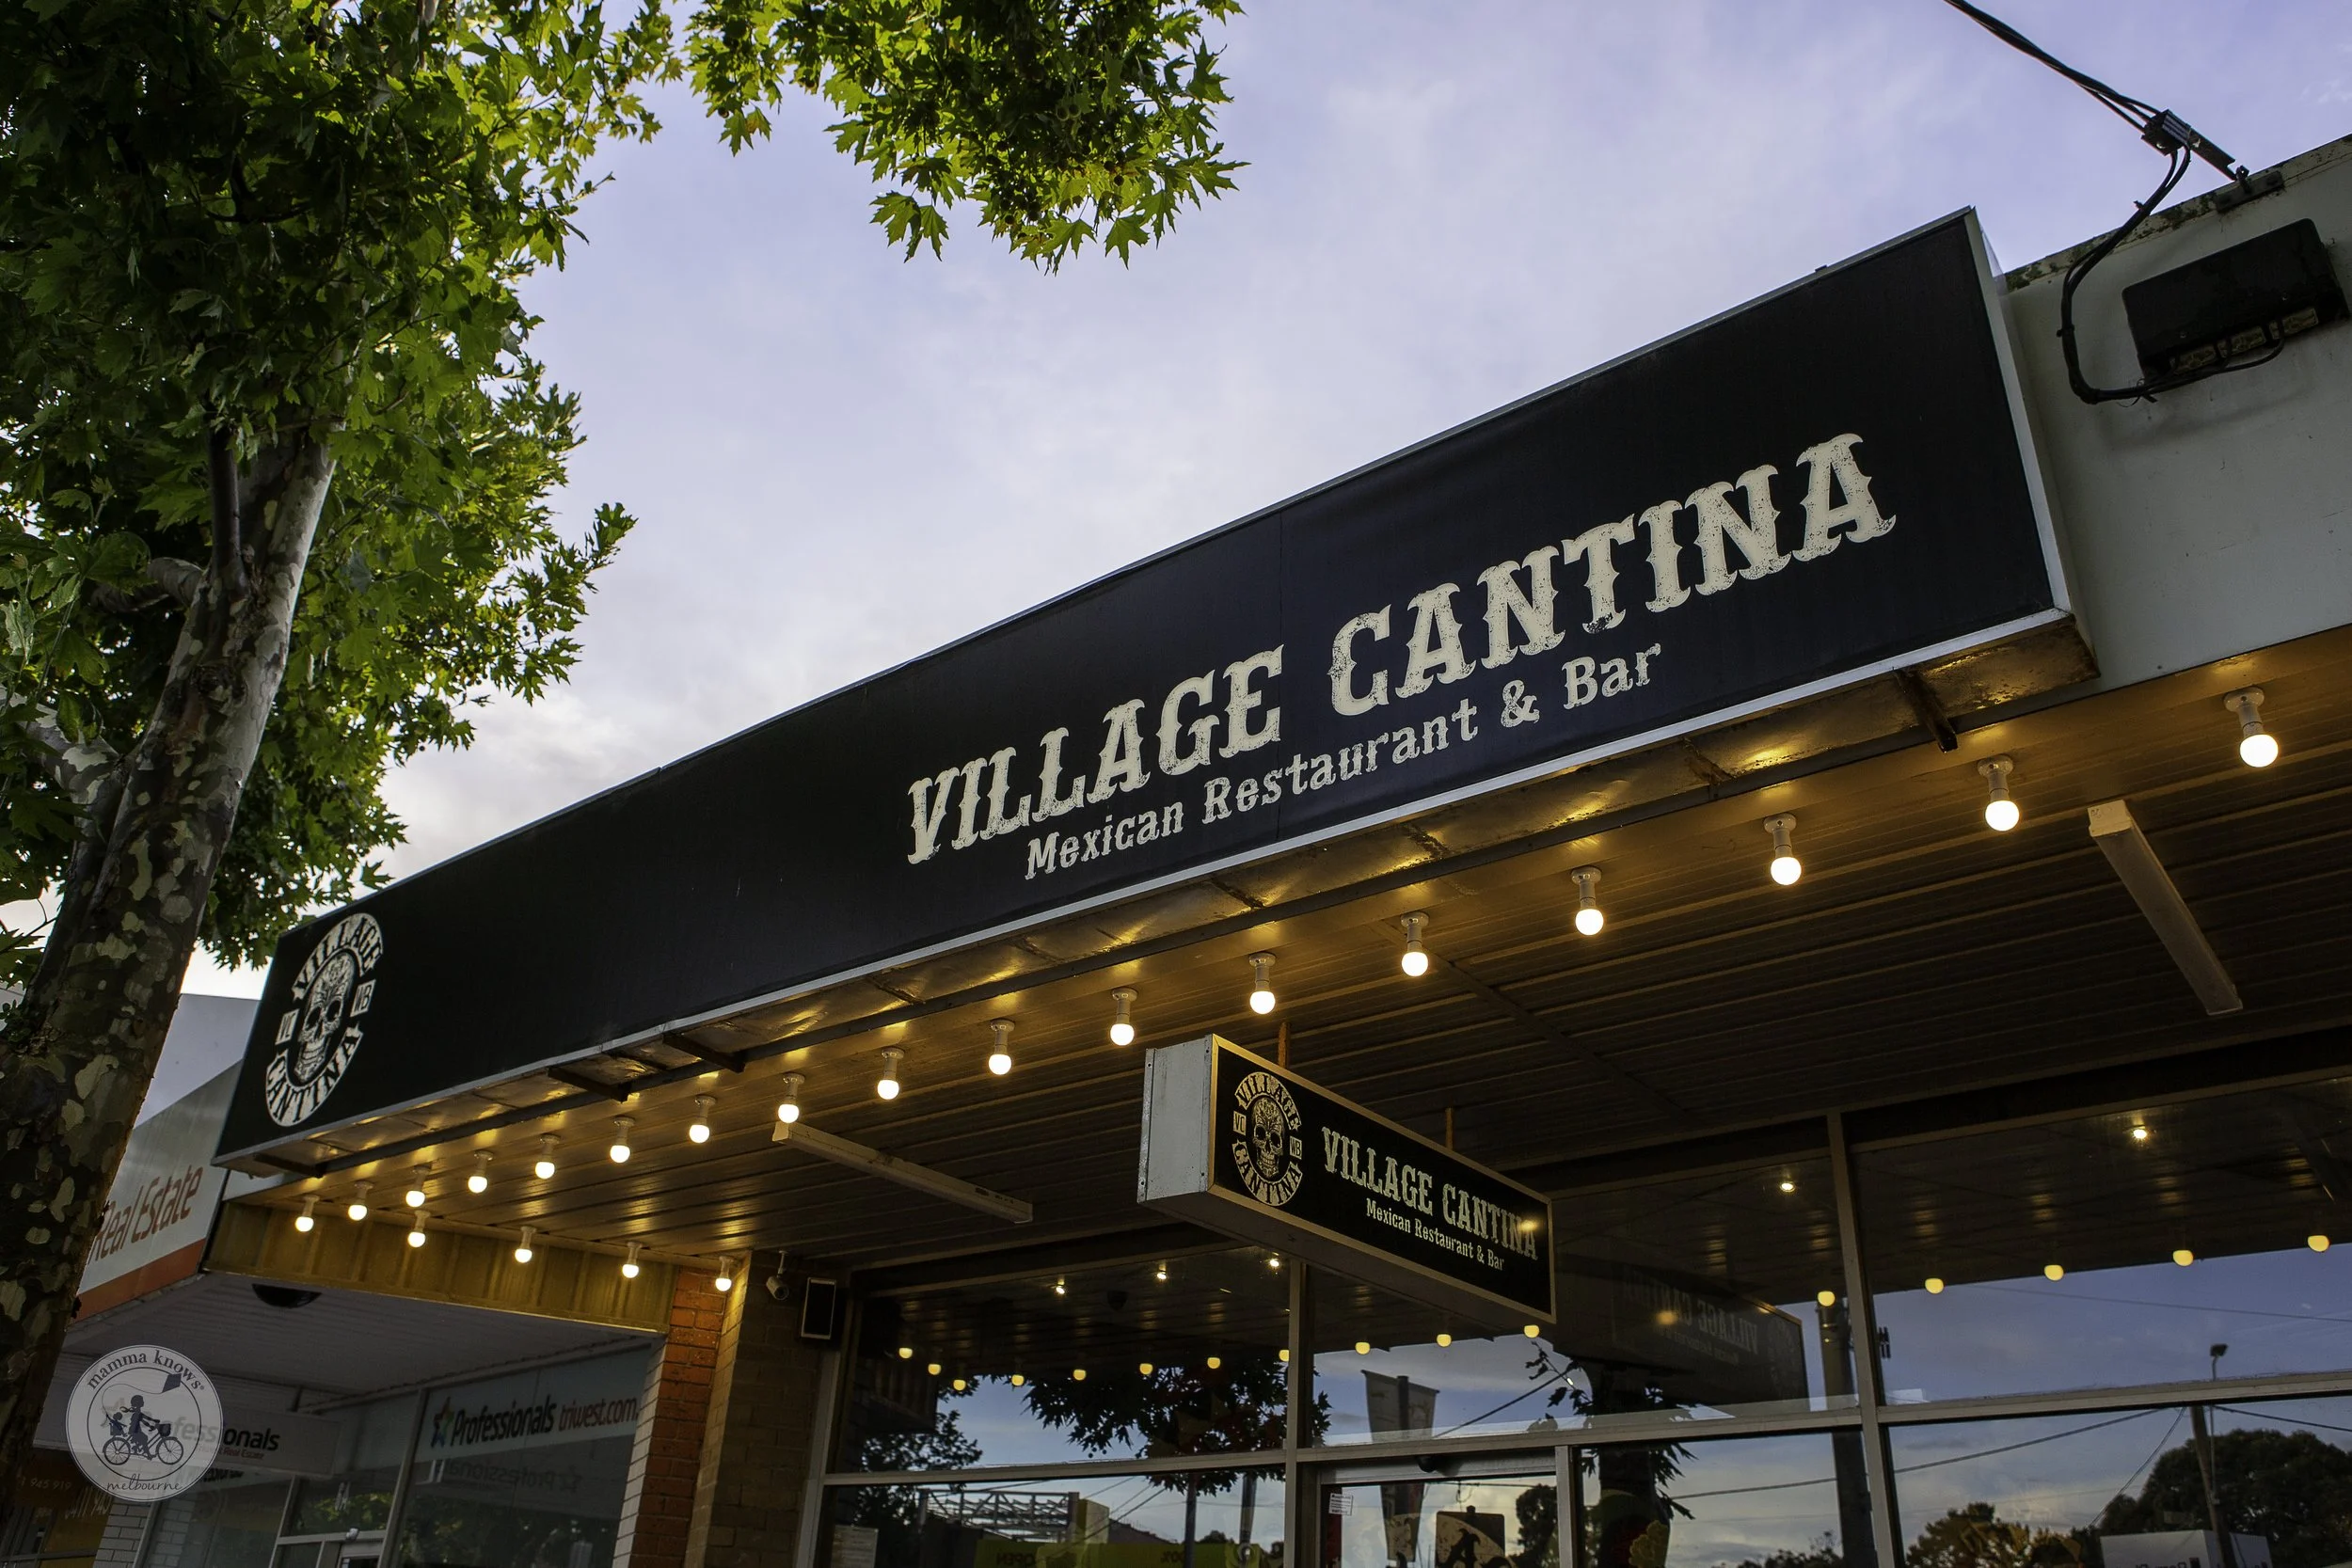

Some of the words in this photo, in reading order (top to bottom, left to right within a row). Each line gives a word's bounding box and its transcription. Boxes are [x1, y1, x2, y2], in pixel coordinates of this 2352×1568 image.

[908, 644, 1284, 864] VILLAGE
[1327, 433, 1896, 717] CANTINA
[1025, 801, 1184, 880] Mexican
[1201, 697, 1479, 825] Restaurant
[1500, 680, 1540, 728] &
[1561, 642, 1661, 710] Bar
[294, 916, 382, 988] VILLAGE
[267, 1034, 361, 1123] CANTINA
[1236, 1074, 1301, 1128] VILLAGE
[1233, 1112, 1246, 1133] VC
[1290, 1137, 1302, 1158] WB
[131, 1164, 204, 1243] Estate
[1234, 1144, 1301, 1205] CANTINA
[1321, 1126, 1434, 1216] VILLAGE
[1442, 1182, 1539, 1261] CANTINA
[1366, 1197, 1412, 1234] Mexican
[1414, 1217, 1474, 1259] Restaurant
[1476, 1244, 1485, 1265] &
[1486, 1248, 1505, 1271] Bar
[450, 1394, 557, 1448] Professionals
